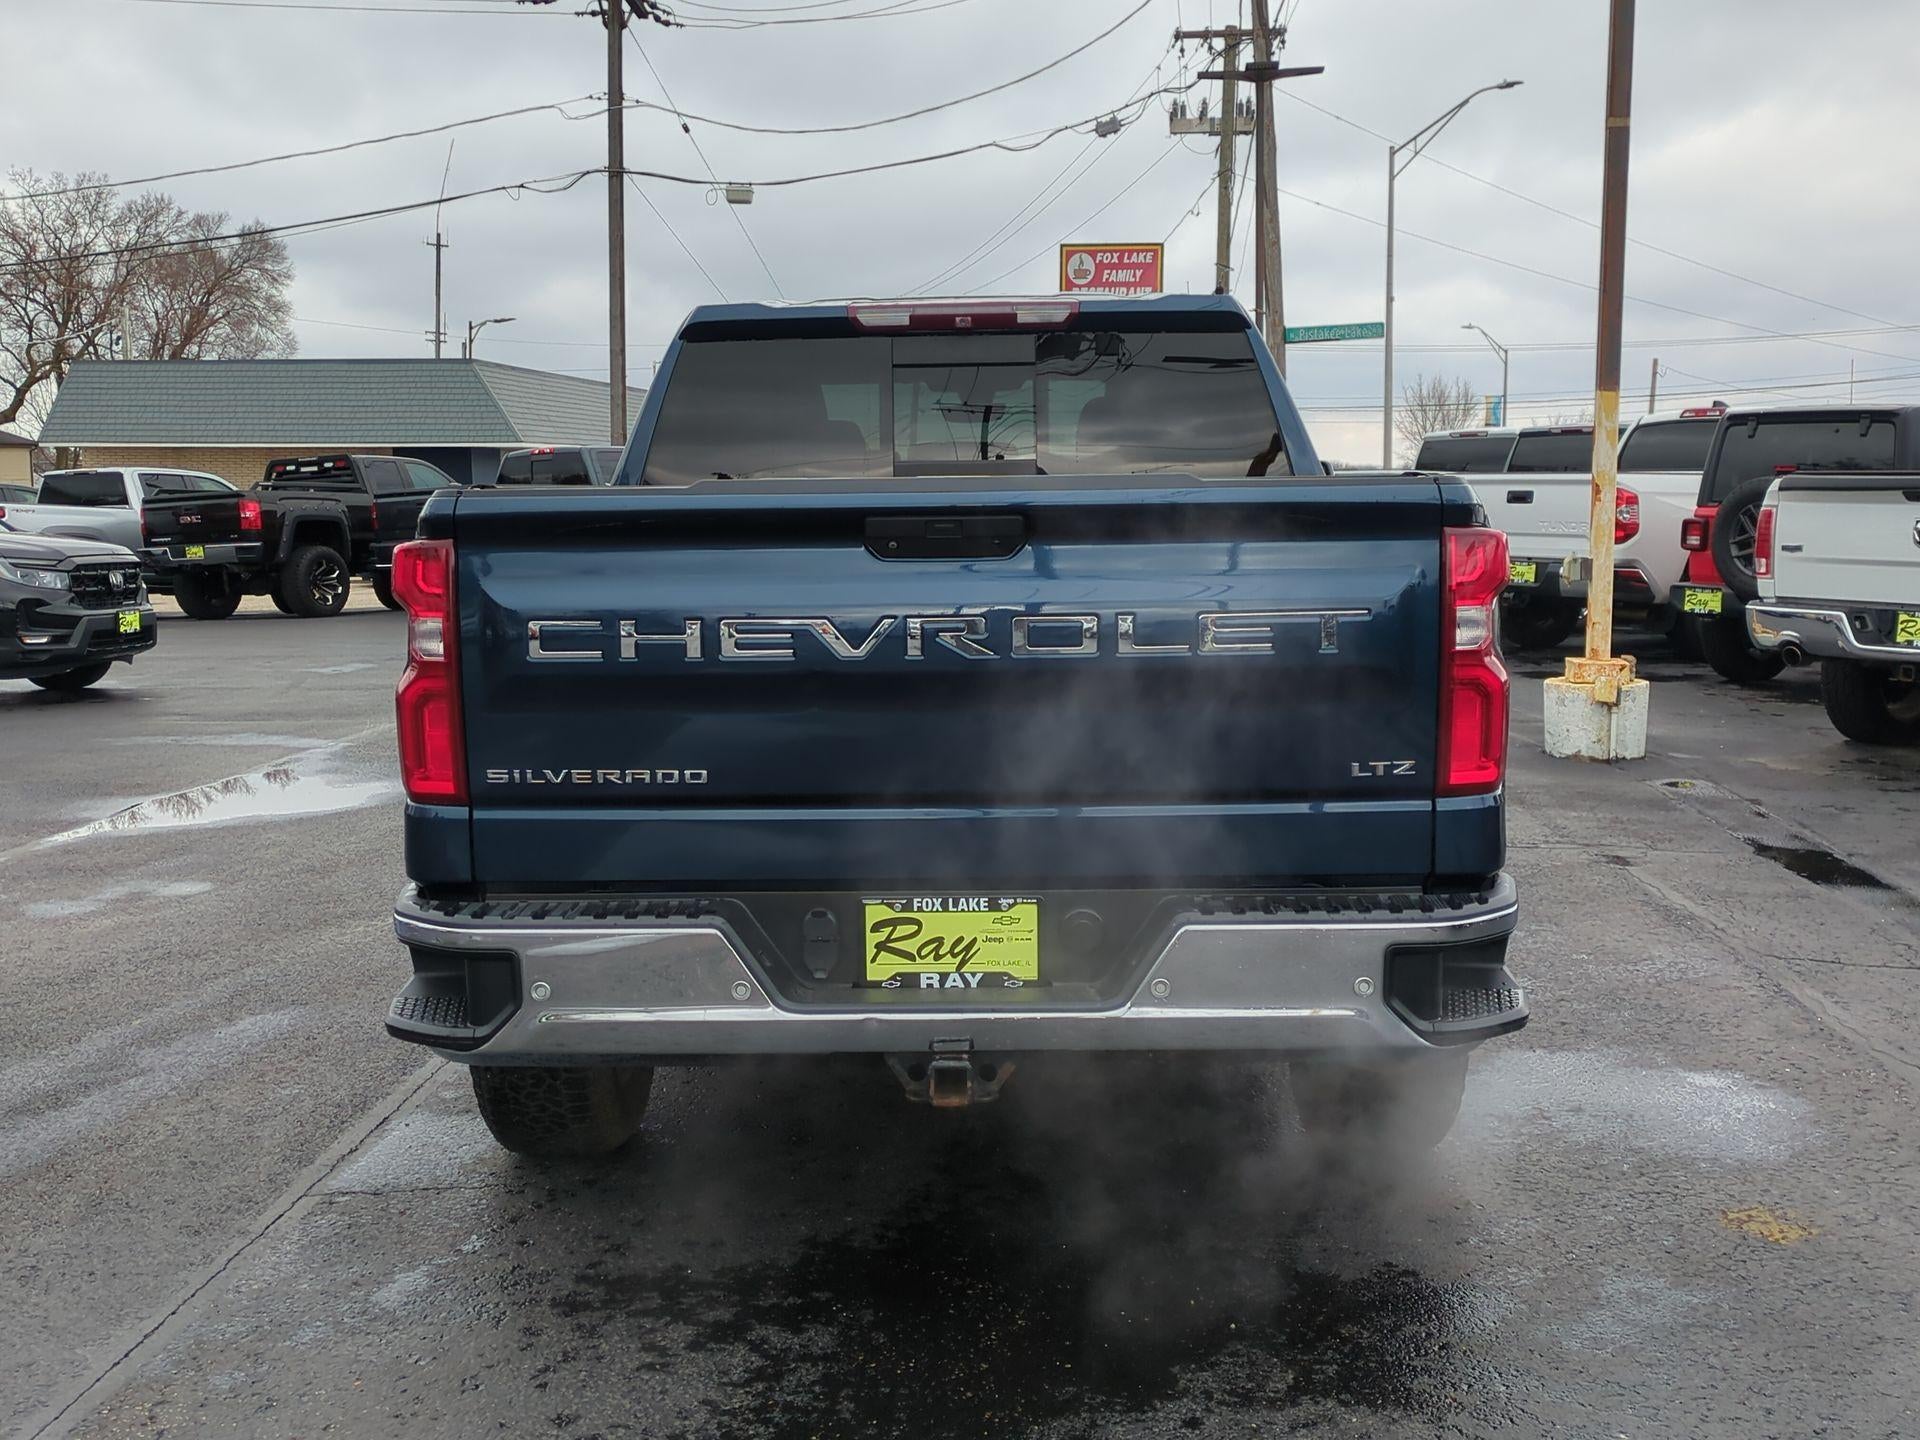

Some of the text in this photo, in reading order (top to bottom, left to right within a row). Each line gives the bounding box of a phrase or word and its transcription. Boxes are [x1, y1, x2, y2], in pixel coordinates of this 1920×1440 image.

[1096, 252, 1154, 264] FOX LAKE
[1102, 269, 1143, 282] FAMILY
[1538, 520, 1591, 533] TUNDR
[527, 609, 1371, 661] CHEVROLET
[486, 769, 708, 784] SILVERADO
[1351, 761, 1416, 777] LTZ
[913, 897, 989, 912] FOX LAKE
[870, 916, 981, 972] Ray
[981, 935, 1004, 945] Jeep
[920, 972, 985, 989] RAY
